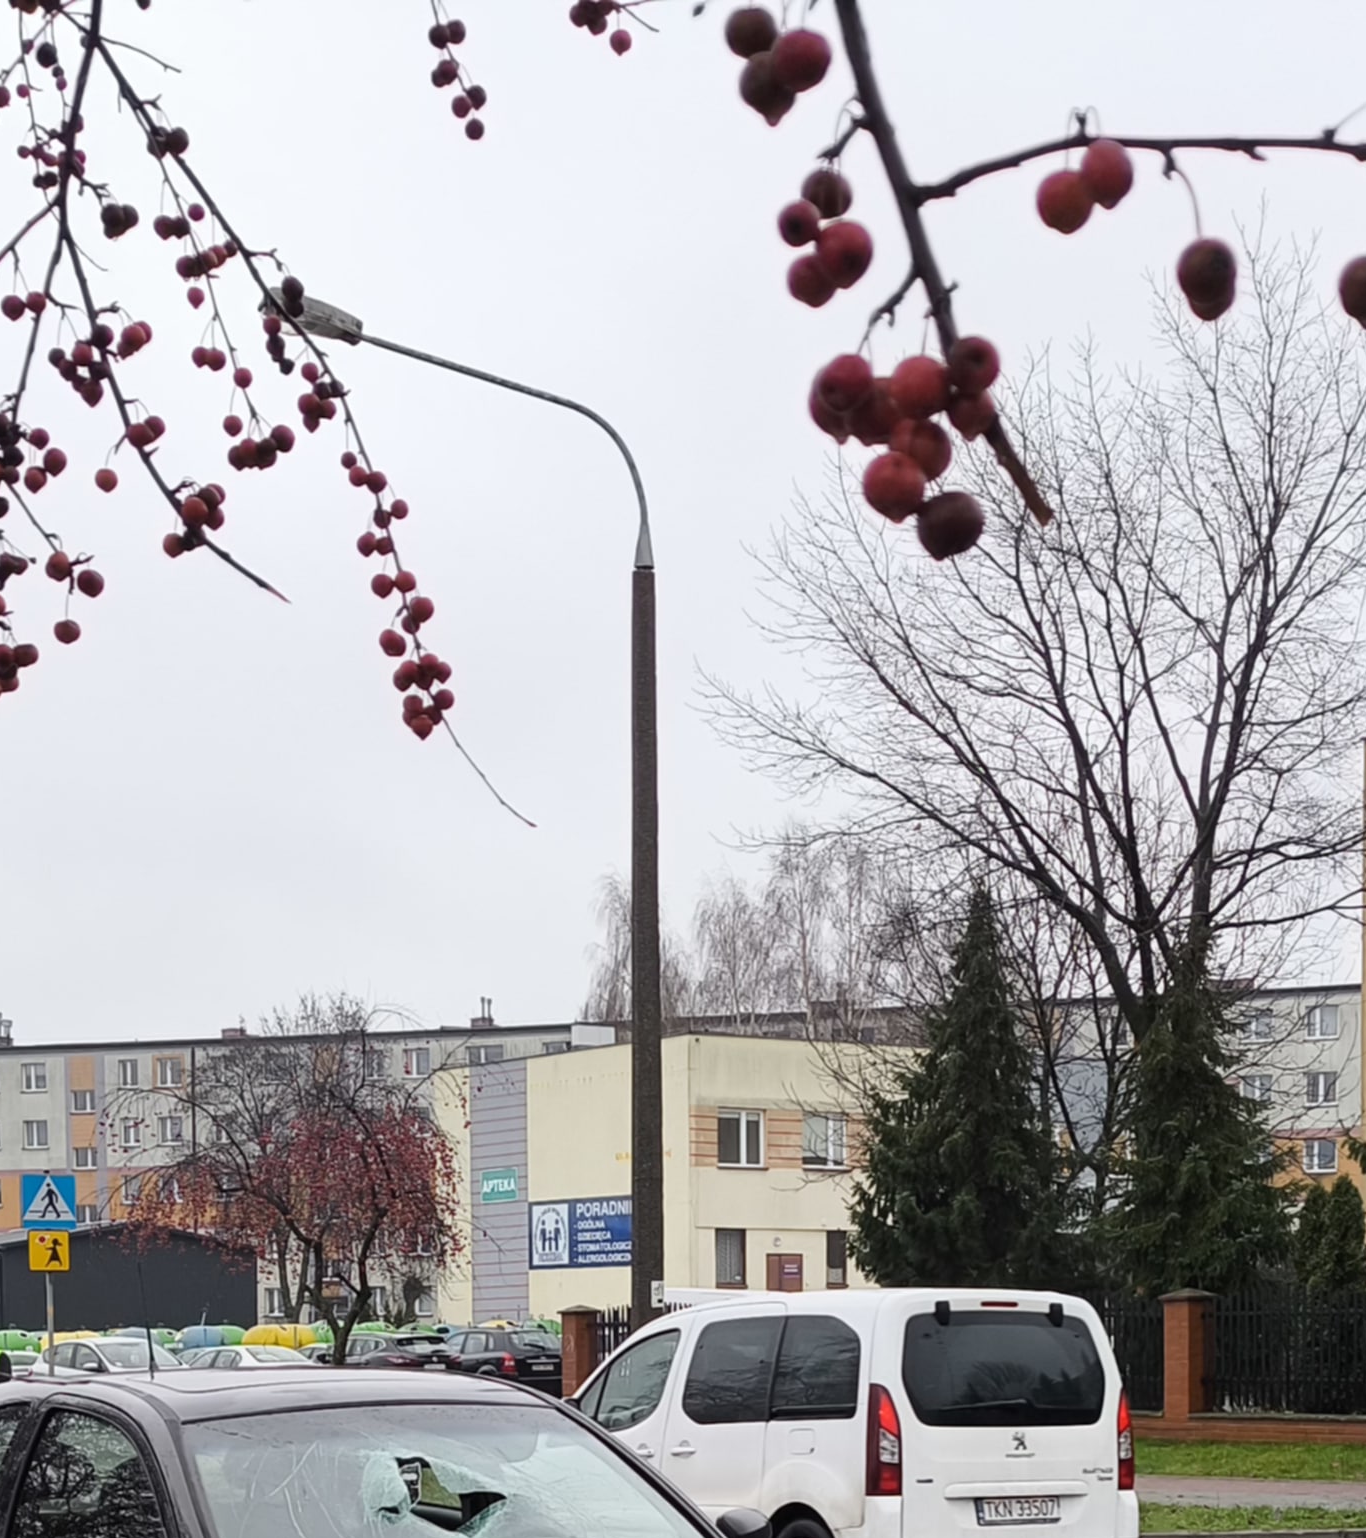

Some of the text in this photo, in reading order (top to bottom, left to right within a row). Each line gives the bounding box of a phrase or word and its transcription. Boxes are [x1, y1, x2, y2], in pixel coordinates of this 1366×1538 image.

[482, 1176, 516, 1193] APTEKA
[984, 1498, 1056, 1517] TKN 33507
